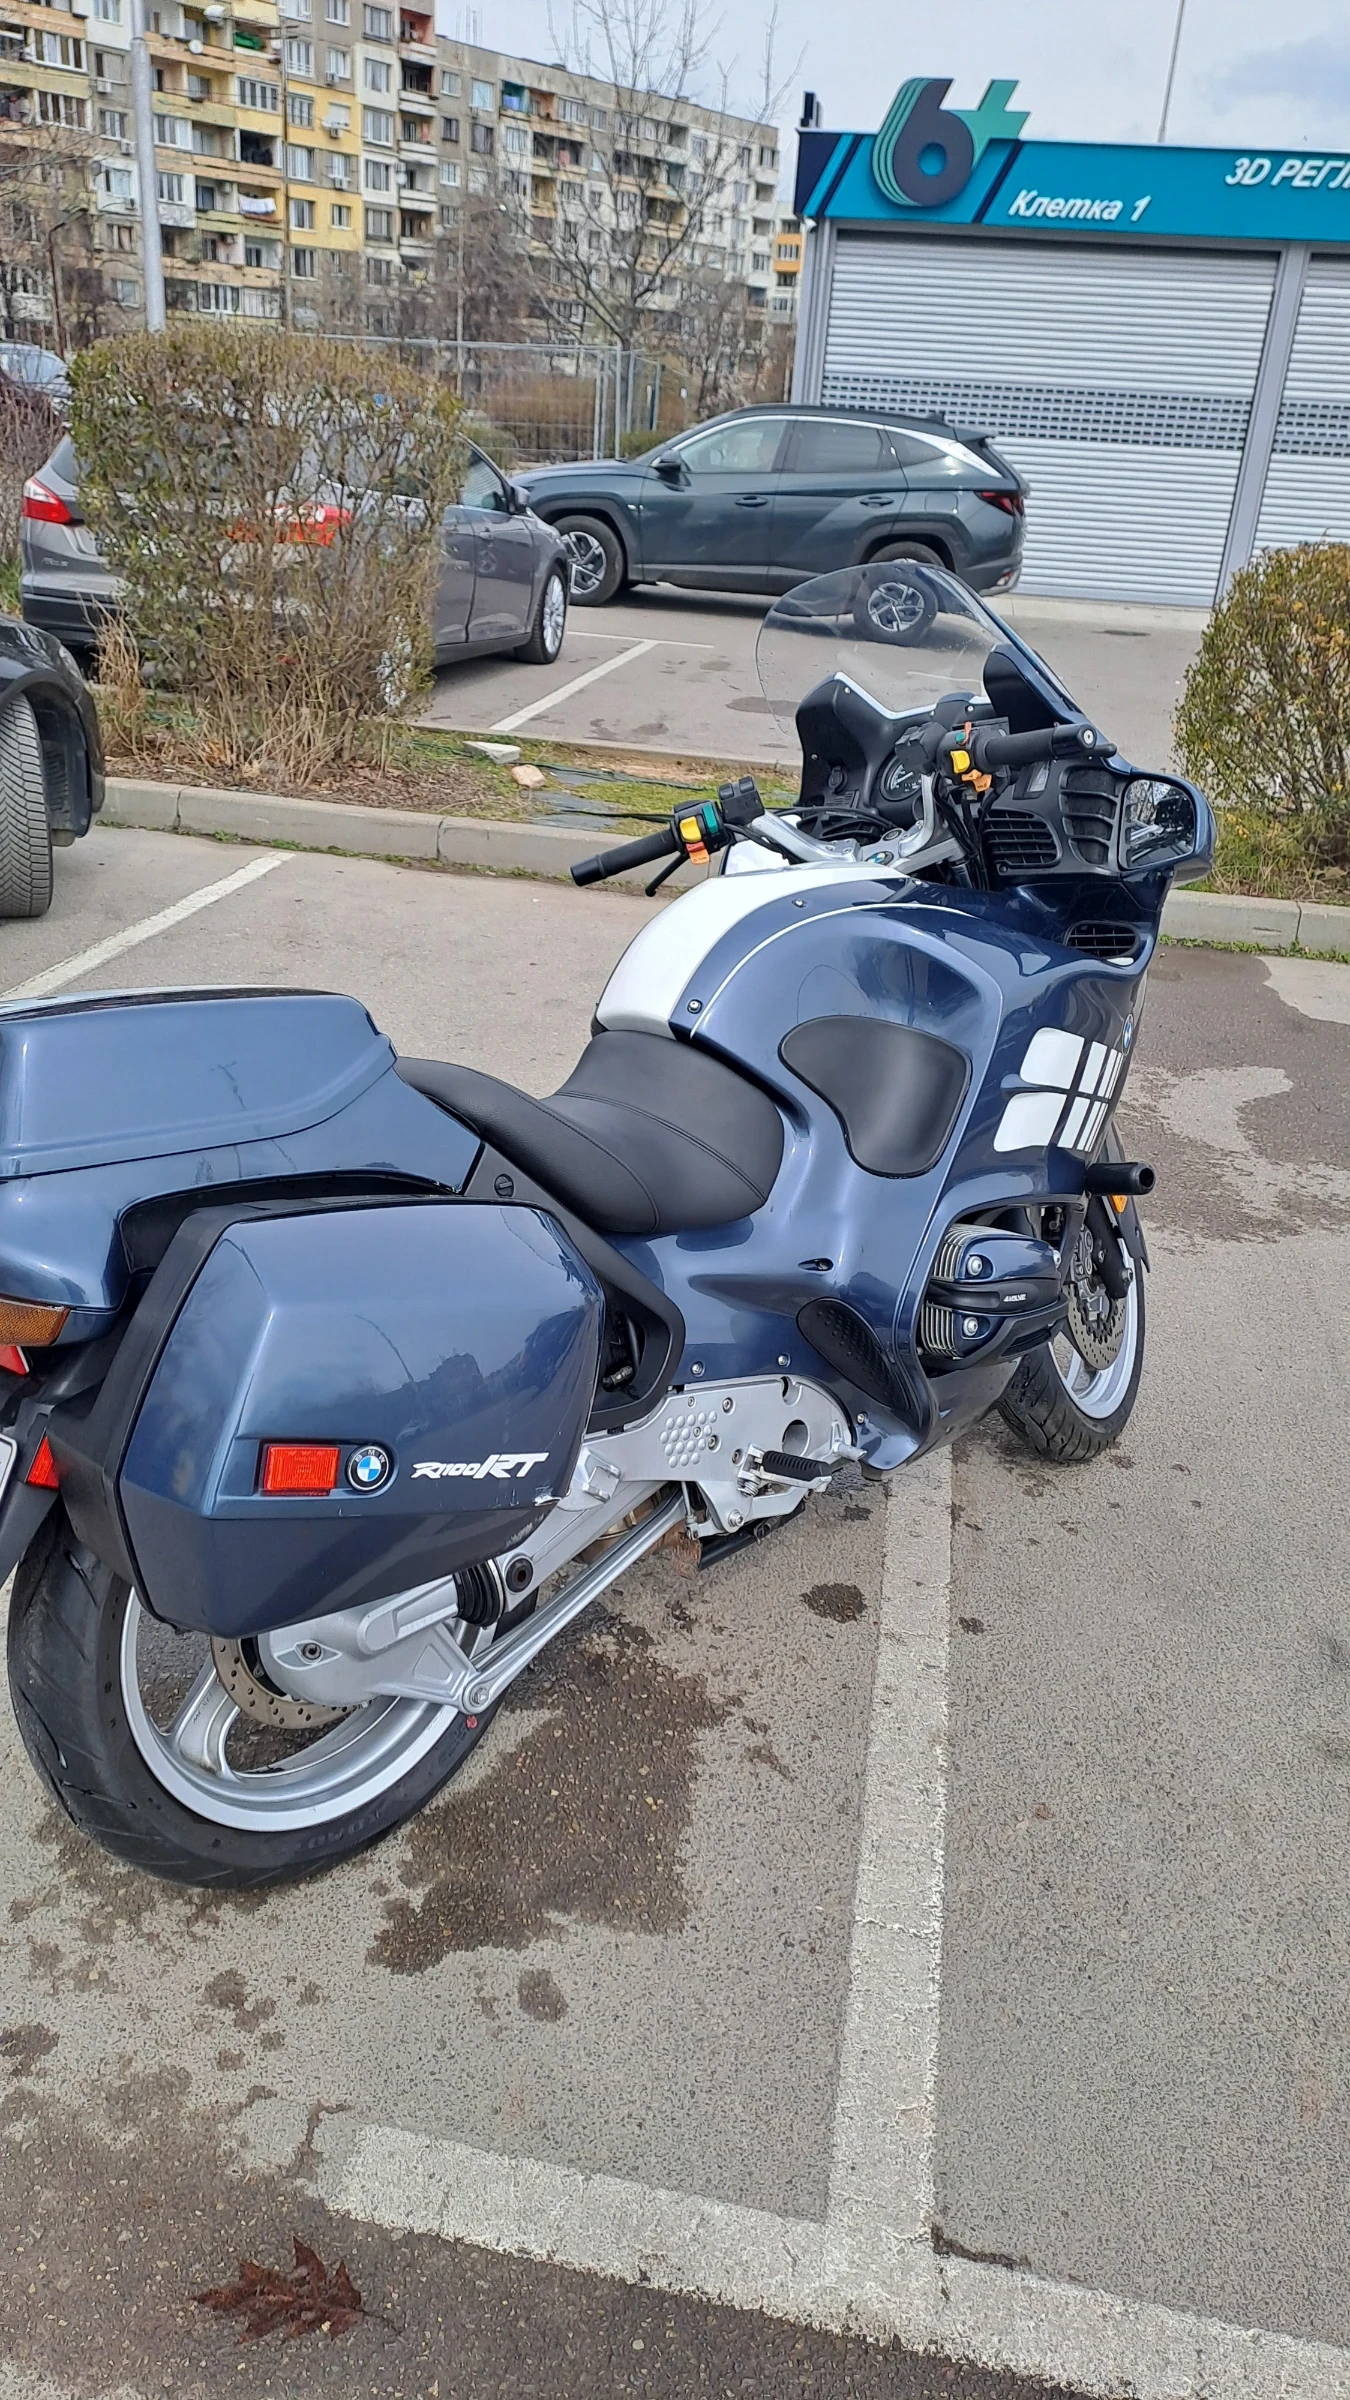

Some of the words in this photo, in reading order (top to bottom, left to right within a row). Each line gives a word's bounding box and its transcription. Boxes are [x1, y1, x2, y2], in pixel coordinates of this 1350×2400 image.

[1225, 157, 1271, 186] 3D
[1008, 189, 1123, 221] Клетка
[1130, 195, 1151, 221] 1
[410, 1452, 549, 1479] R1100RT
